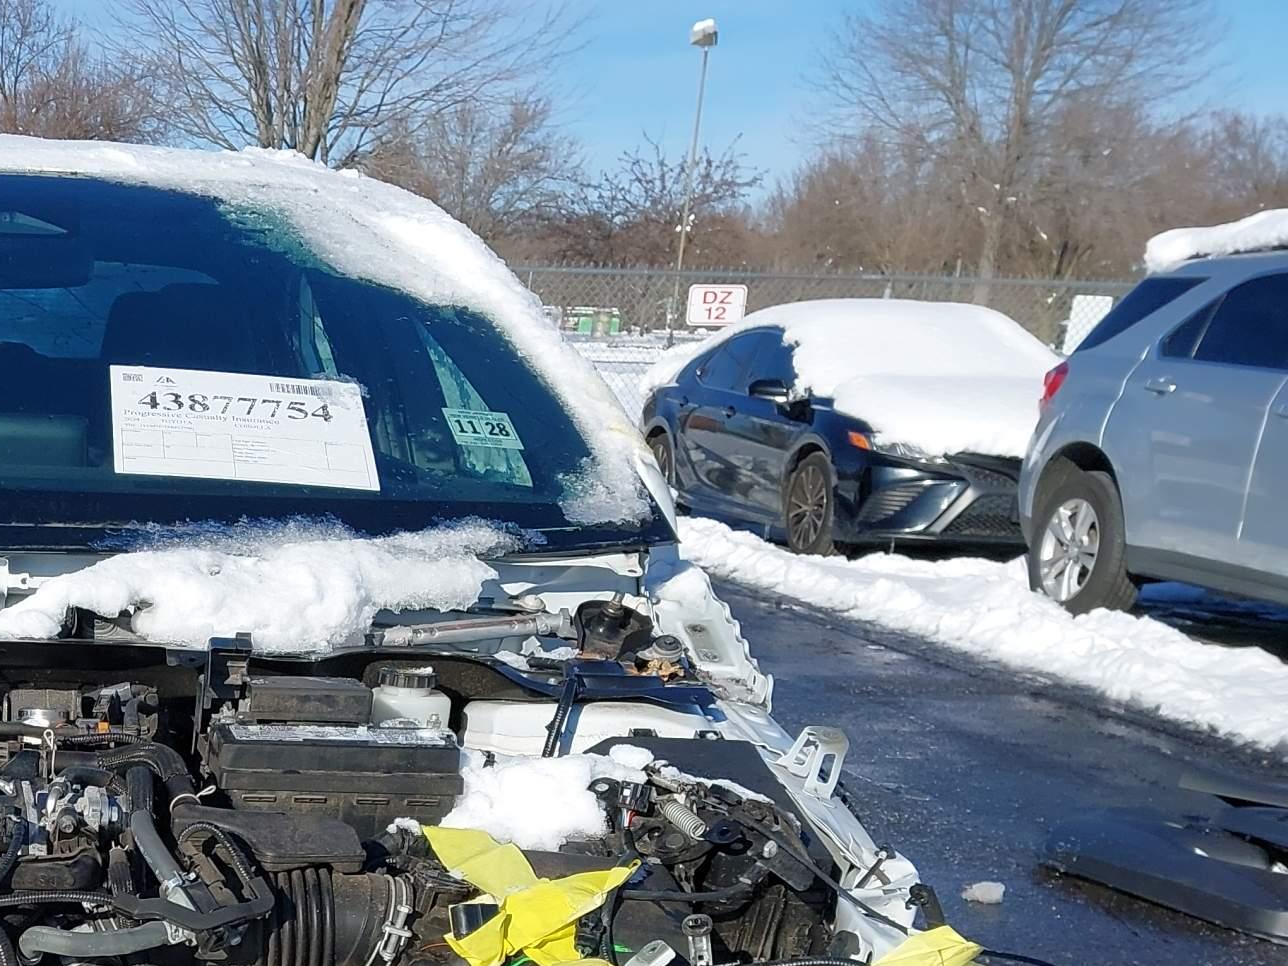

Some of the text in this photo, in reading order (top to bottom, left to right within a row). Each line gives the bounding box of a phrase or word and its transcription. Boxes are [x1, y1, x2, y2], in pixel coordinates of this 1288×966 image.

[703, 290, 733, 304] DZ
[705, 306, 727, 320] 12
[123, 408, 183, 418] Progressive
[137, 391, 333, 422] 43877754
[455, 420, 510, 436] 11 28
